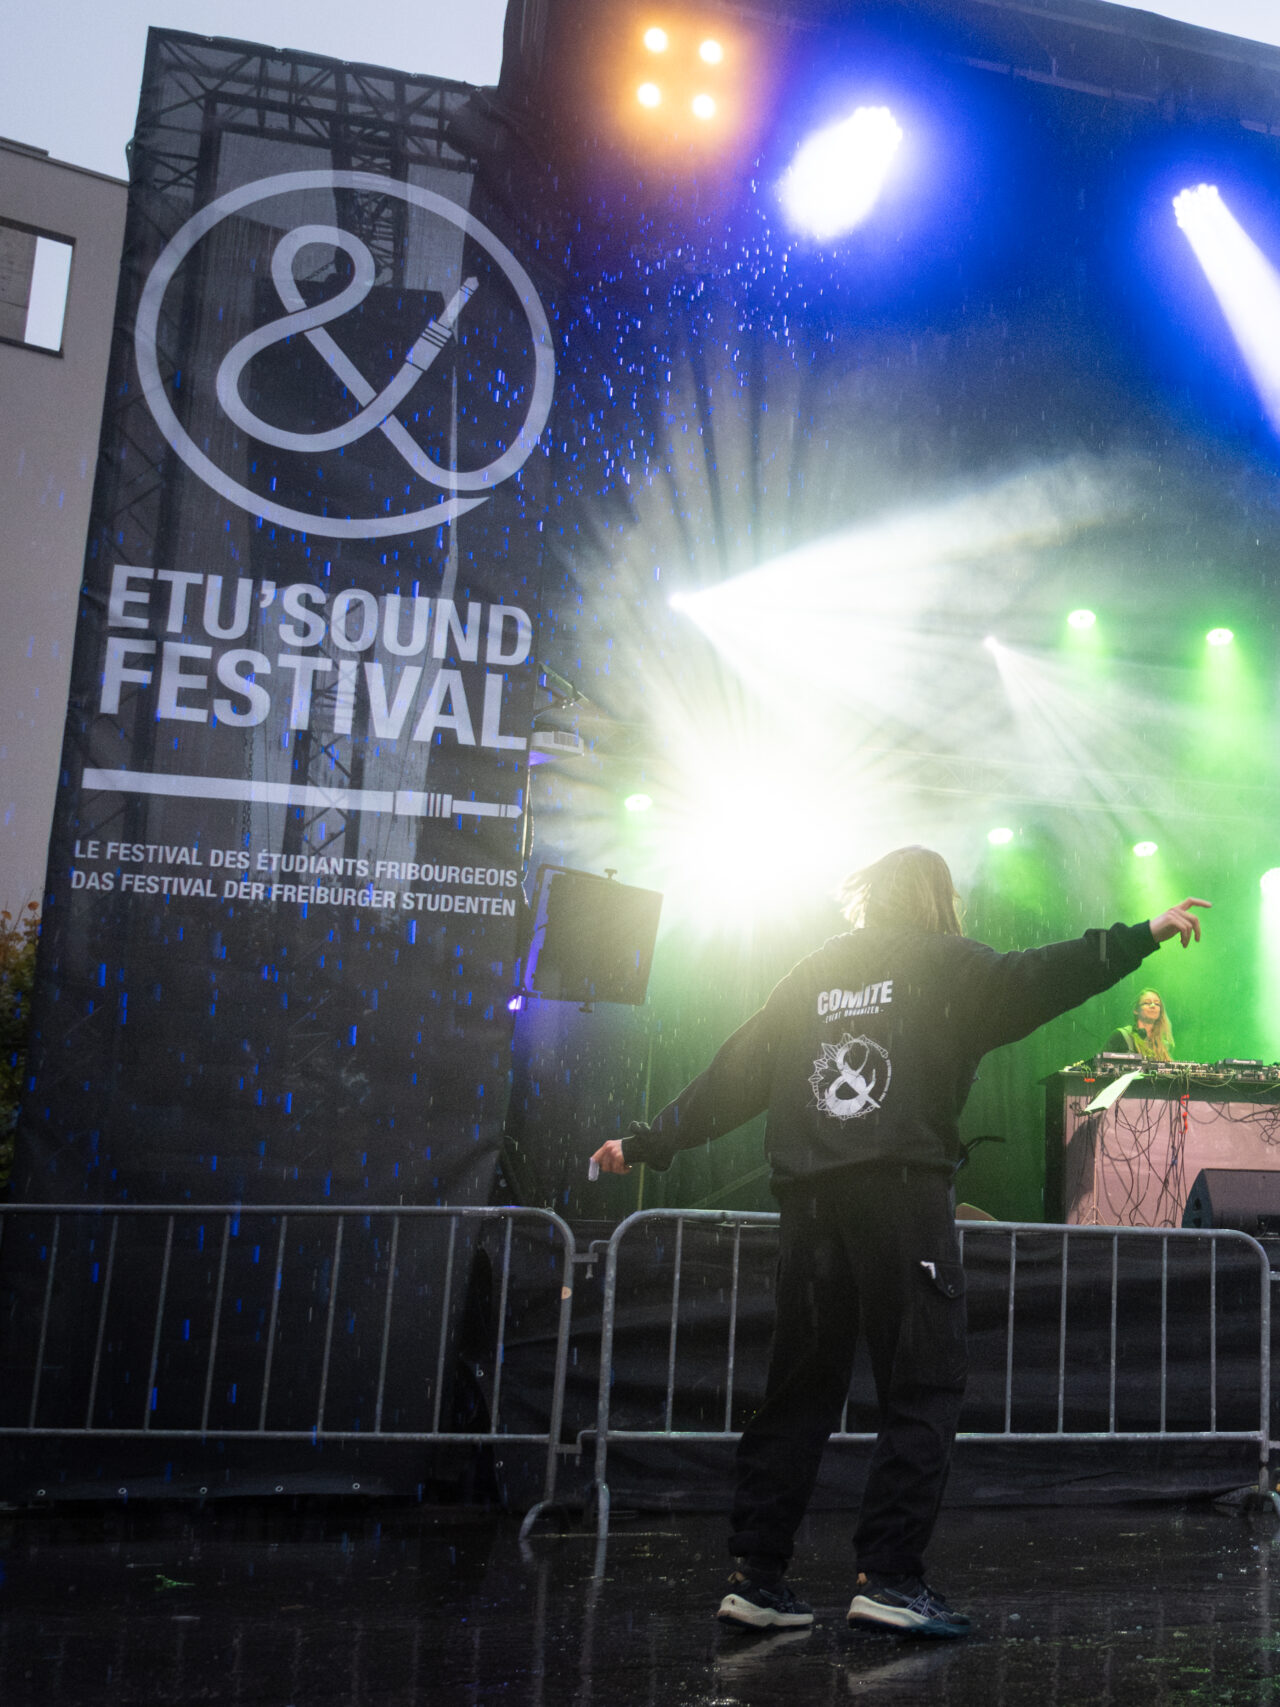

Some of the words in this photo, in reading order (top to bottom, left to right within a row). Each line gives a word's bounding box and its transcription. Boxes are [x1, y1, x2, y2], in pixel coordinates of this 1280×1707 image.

[99, 636, 528, 751] FESTIVAL
[74, 839, 100, 859] LE
[105, 842, 203, 866] FESTIVAL
[210, 849, 250, 870] DES
[256, 848, 369, 877] ÉTUDIANTS
[375, 860, 518, 888] FRIBOURGEOIS
[71, 870, 115, 890] DAS
[120, 873, 217, 898] FESTIVAL
[224, 880, 265, 901] DER
[271, 883, 396, 910] FREIBURGER
[402, 892, 516, 917] STUDENTEN
[817, 980, 893, 1015] COMITE
